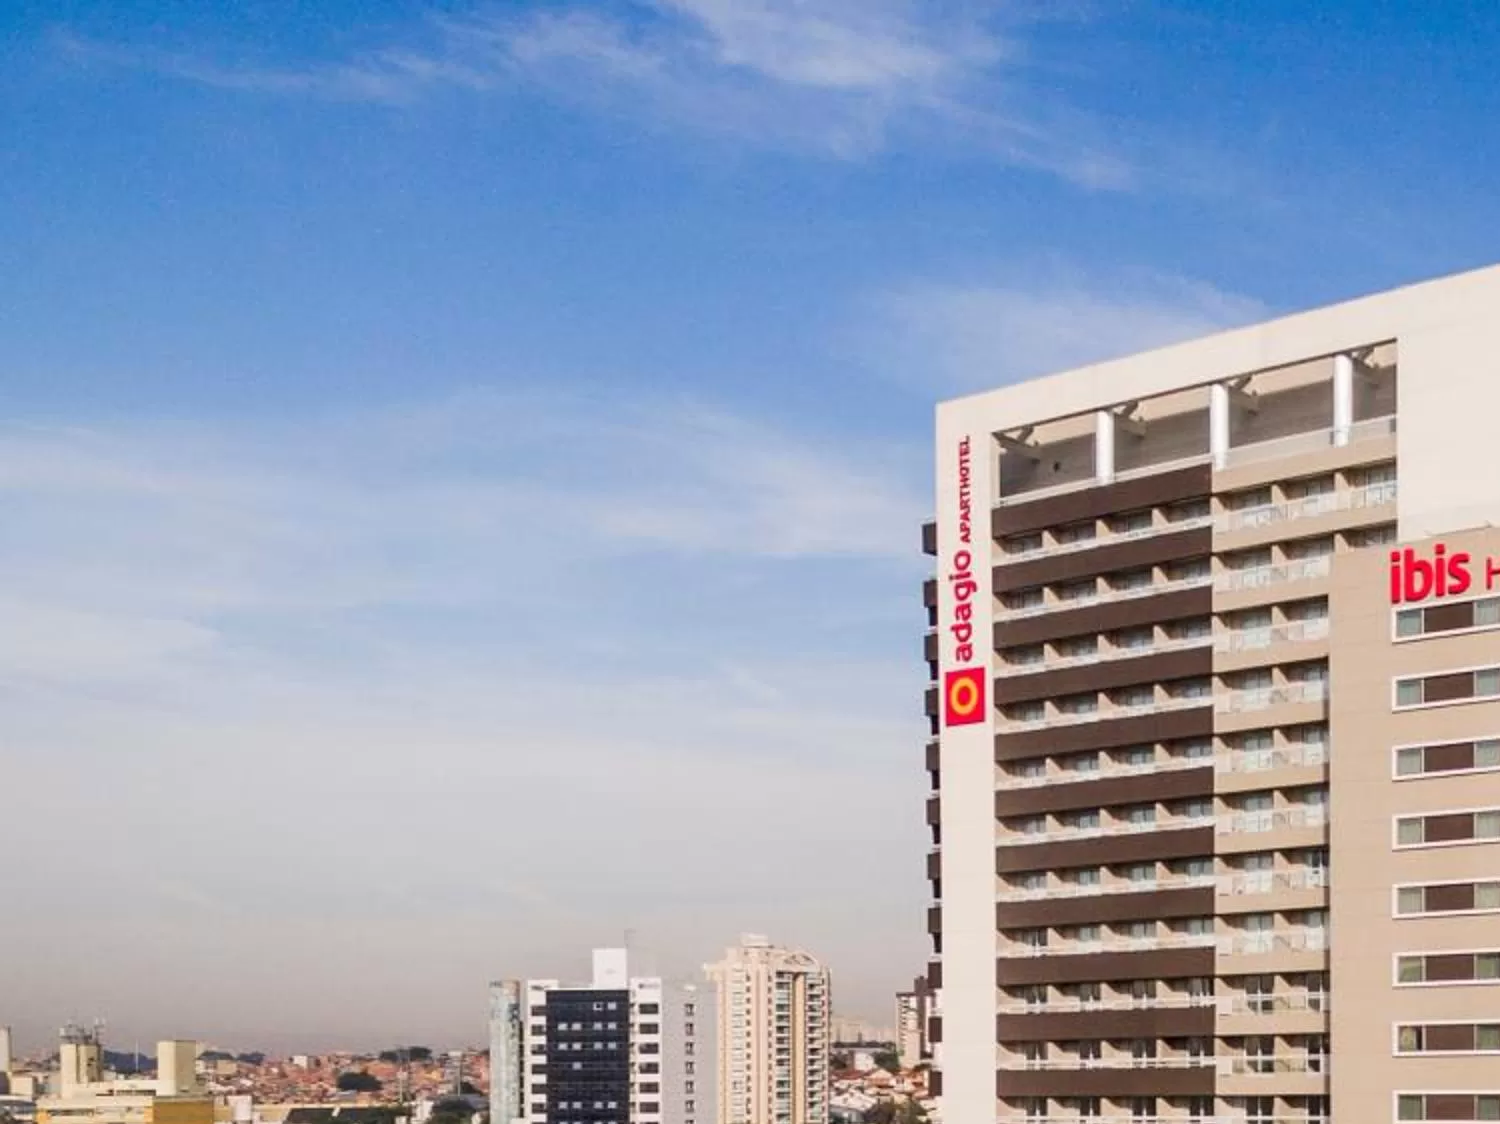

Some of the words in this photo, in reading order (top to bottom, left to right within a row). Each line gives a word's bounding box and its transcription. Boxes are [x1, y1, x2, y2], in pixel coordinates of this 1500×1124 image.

[958, 435, 971, 544] APARTHOTEL
[949, 549, 977, 662] adagio
[1391, 543, 1471, 604] ibis
